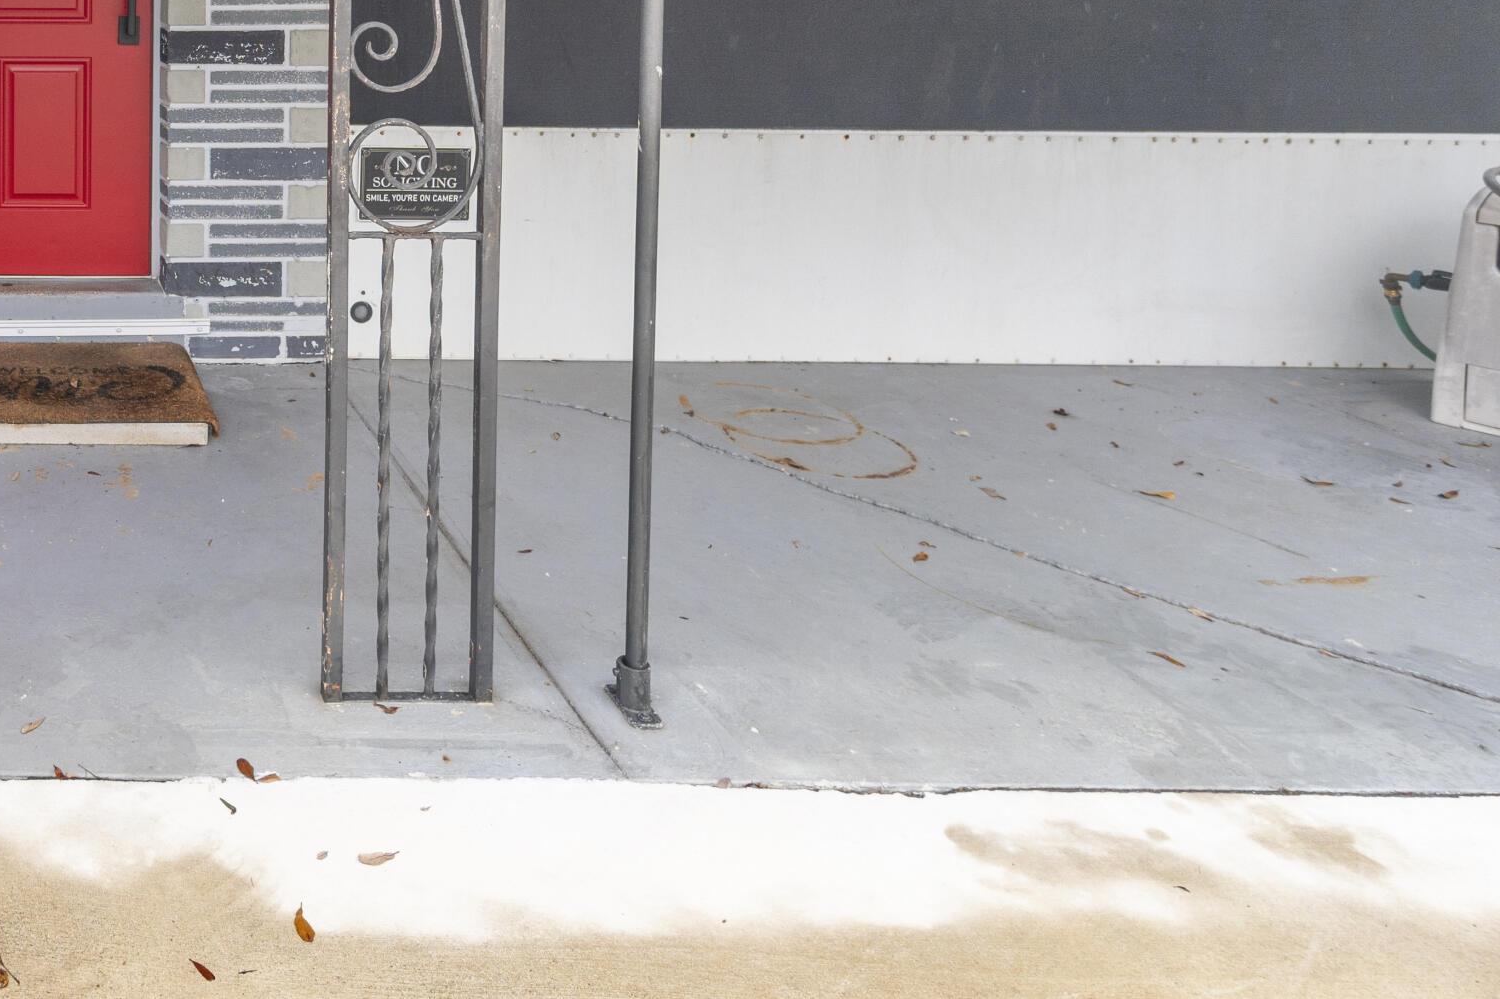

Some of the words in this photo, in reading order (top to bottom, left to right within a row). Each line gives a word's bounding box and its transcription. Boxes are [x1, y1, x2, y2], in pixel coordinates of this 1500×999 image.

[366, 194, 390, 203] SMILE,
[419, 194, 431, 202] ON
[432, 194, 462, 203] CAMER
